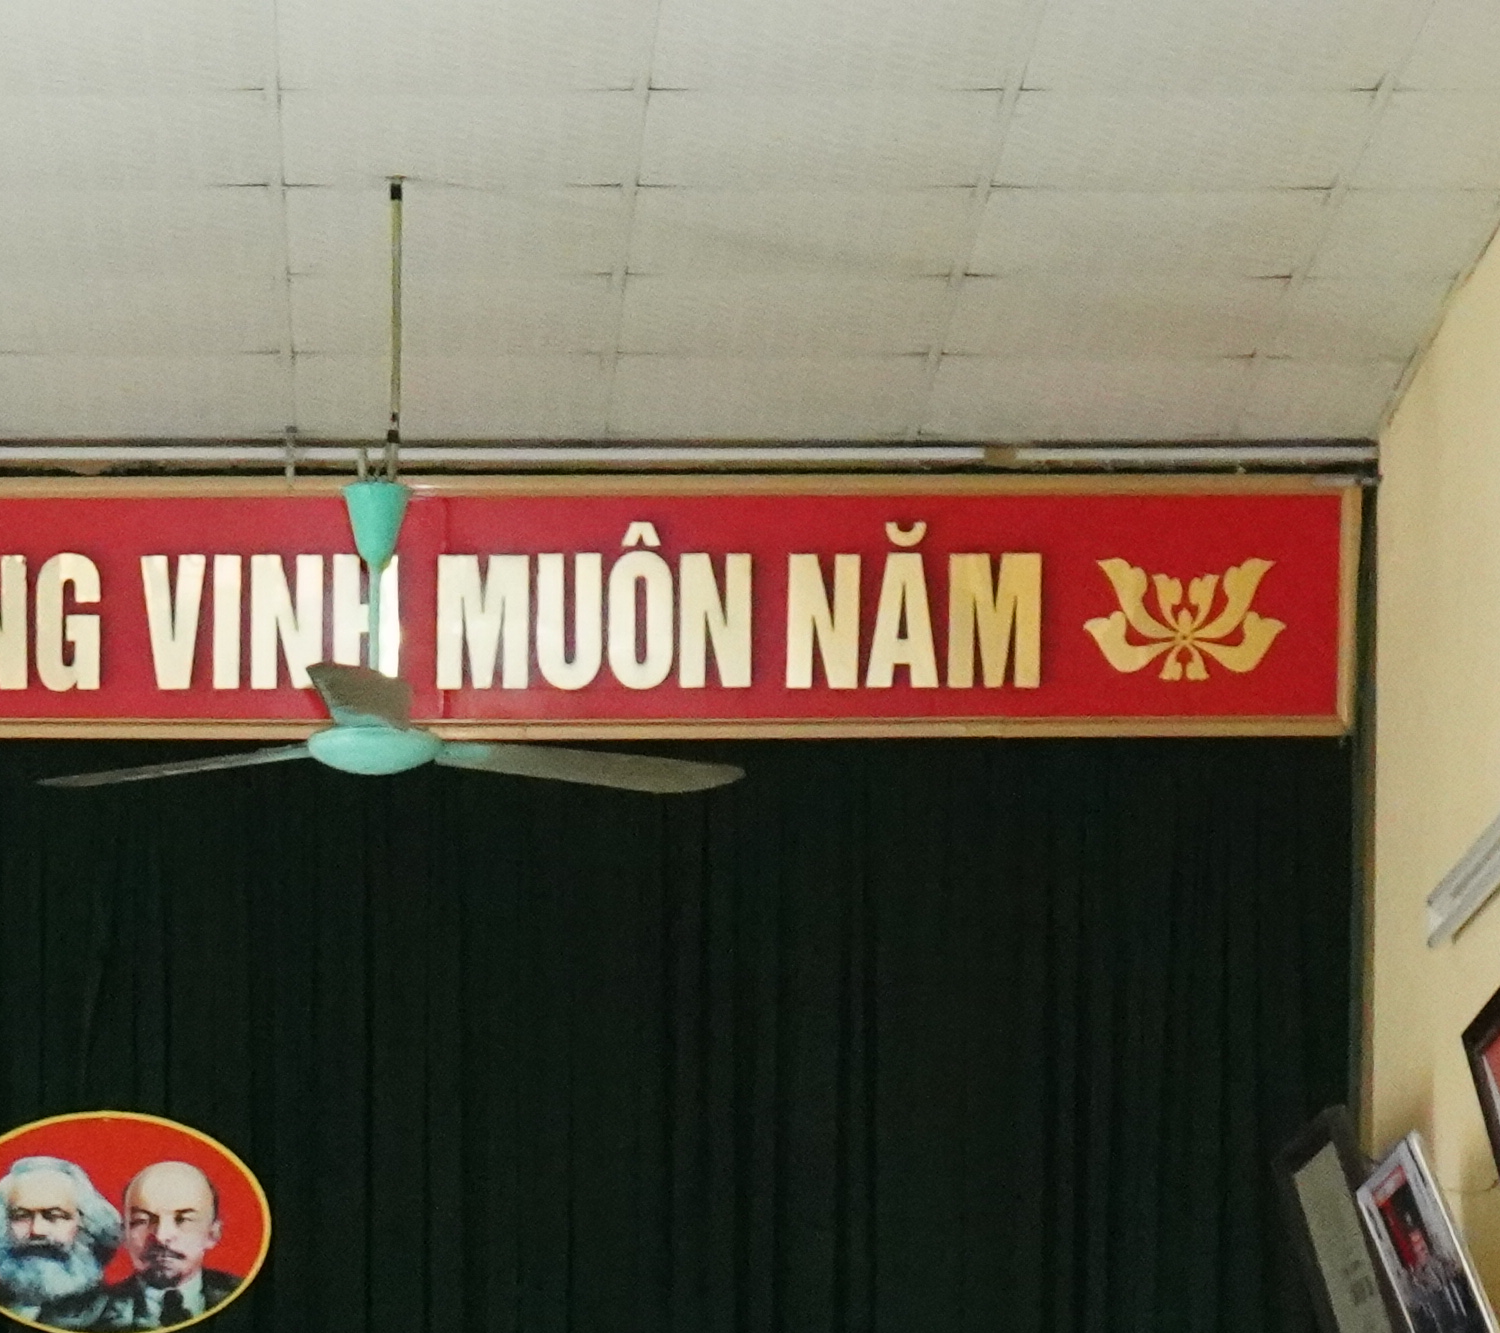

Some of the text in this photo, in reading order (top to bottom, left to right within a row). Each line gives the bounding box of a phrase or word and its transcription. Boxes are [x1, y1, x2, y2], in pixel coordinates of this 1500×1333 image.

[140, 554, 400, 691] VINH
[436, 521, 753, 690] MUÔN
[785, 521, 1043, 689] NĂM
